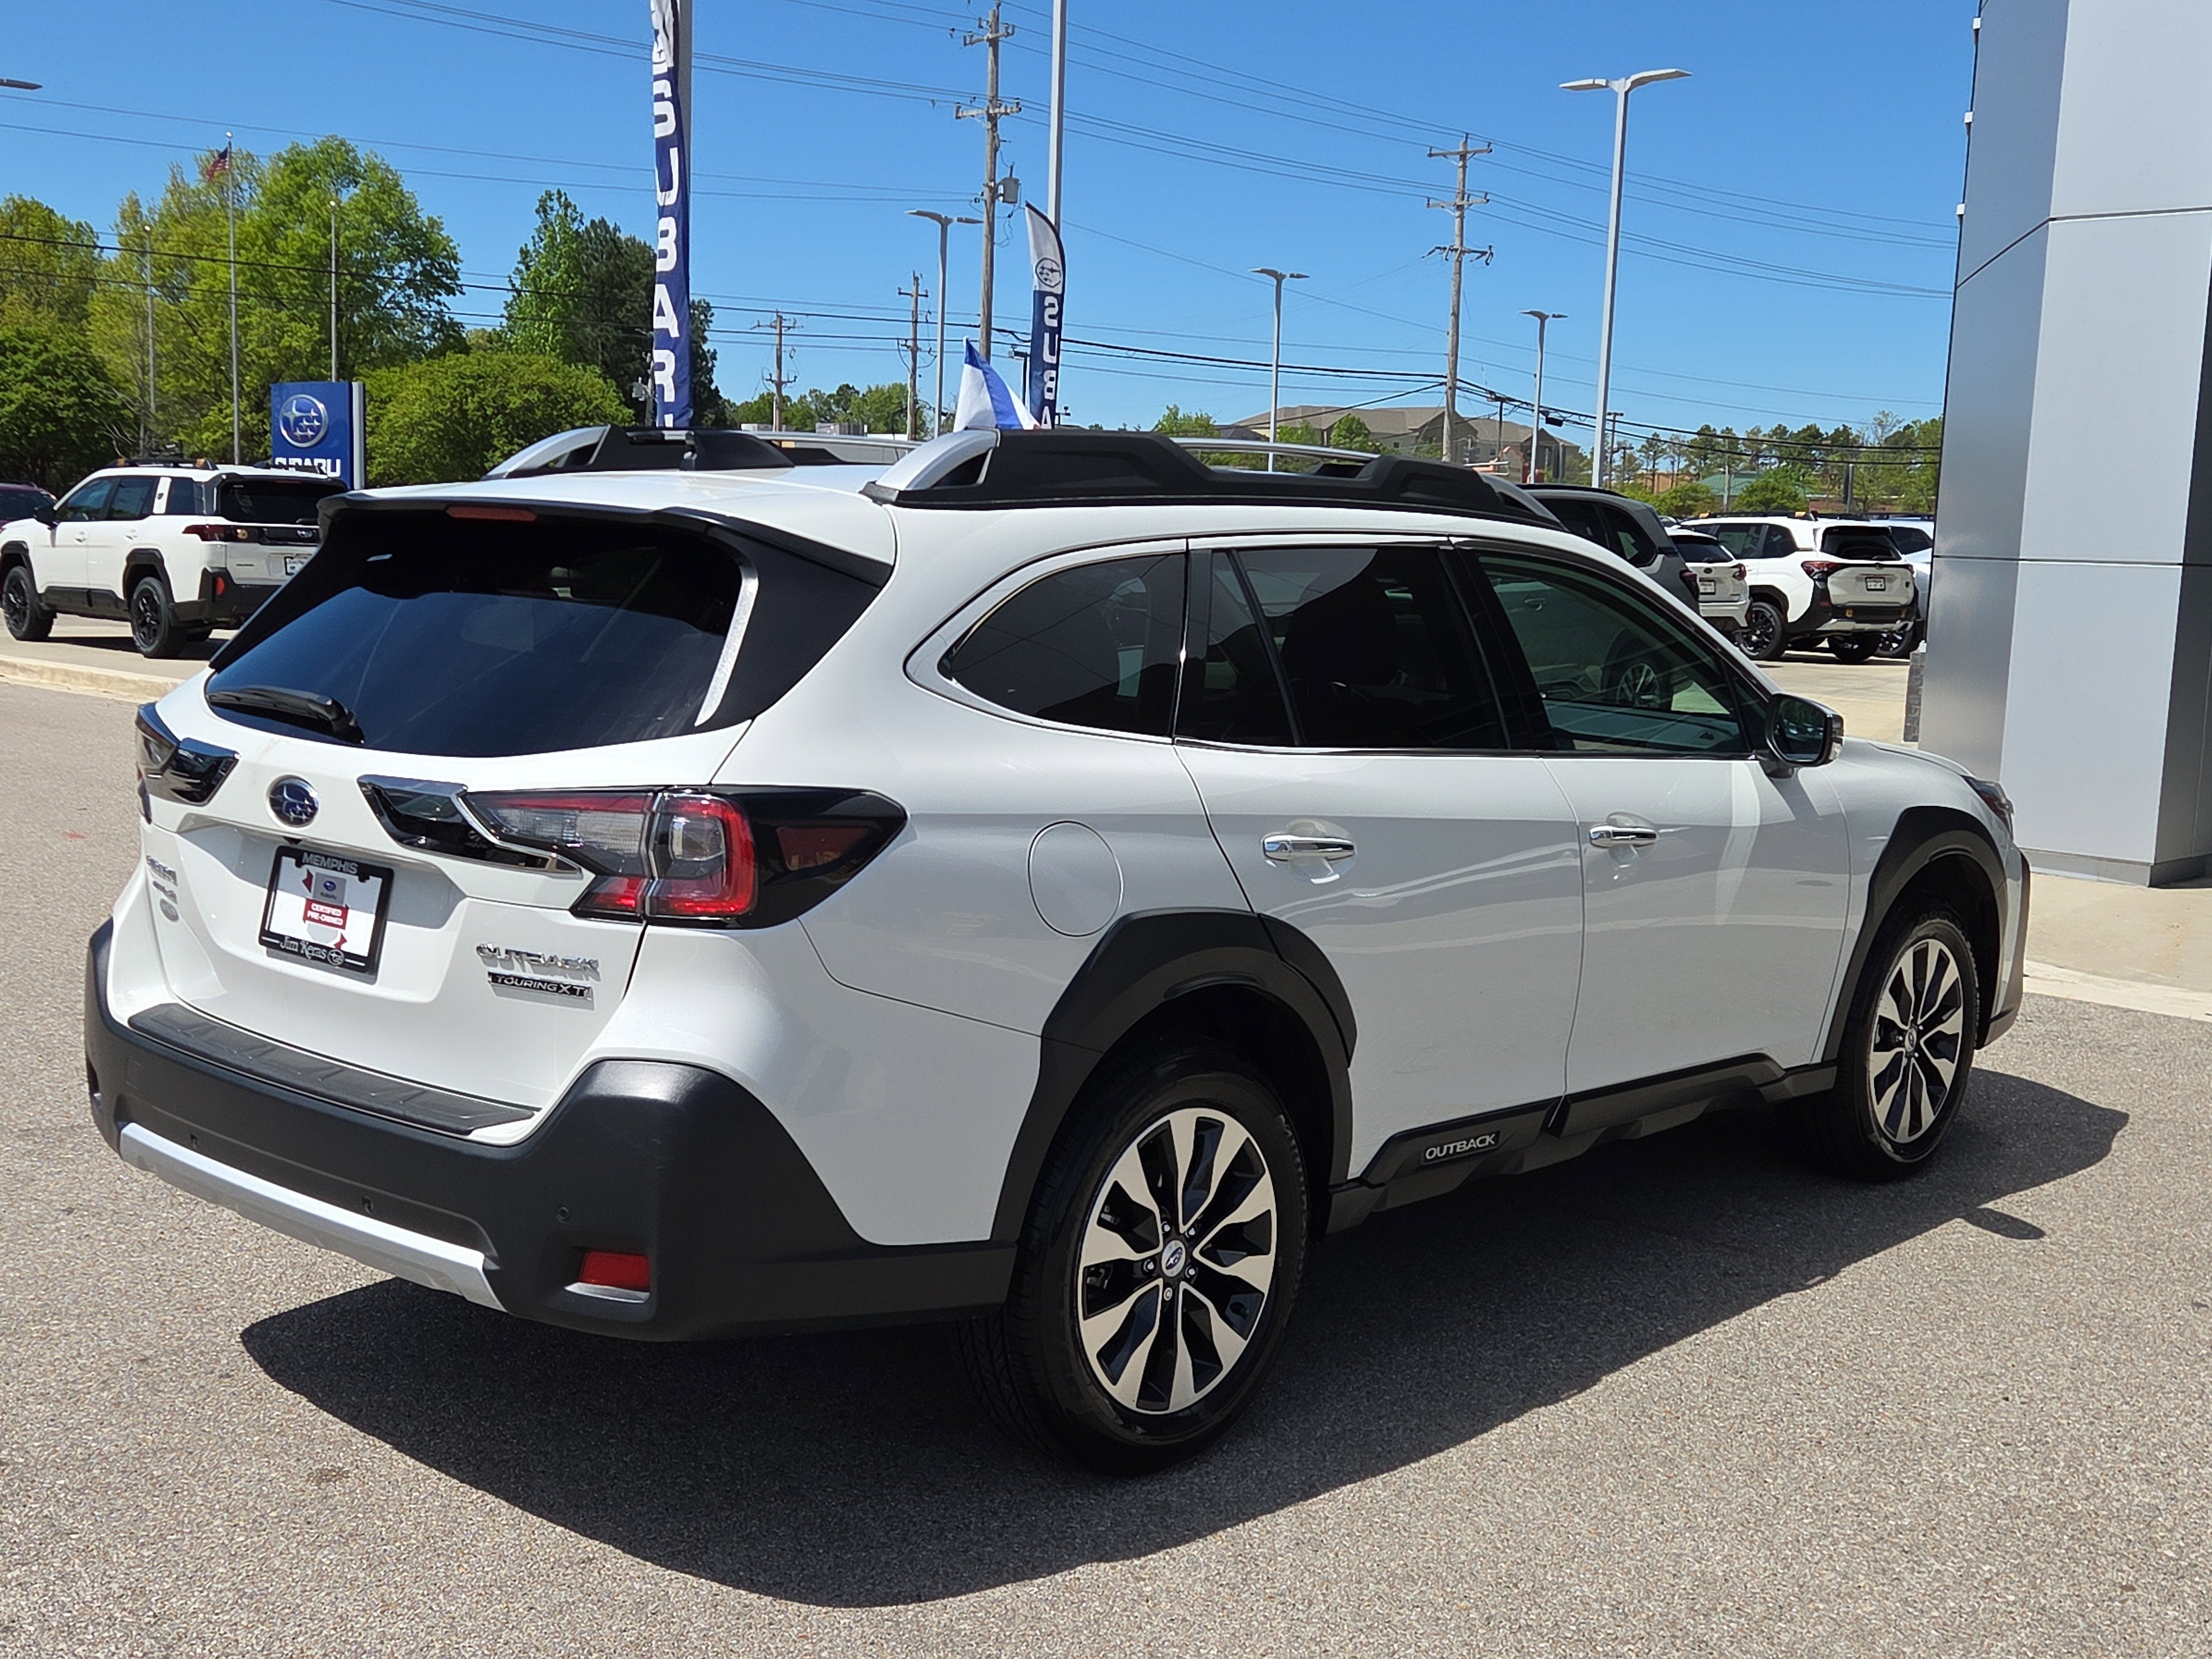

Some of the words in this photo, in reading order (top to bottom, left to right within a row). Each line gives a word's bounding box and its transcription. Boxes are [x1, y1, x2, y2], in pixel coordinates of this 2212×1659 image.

[653, 80, 679, 428] SUBAR
[302, 852, 358, 874] MEMPHIS
[280, 936, 299, 952] Jim
[1425, 1134, 1496, 1160] OUTBACK
